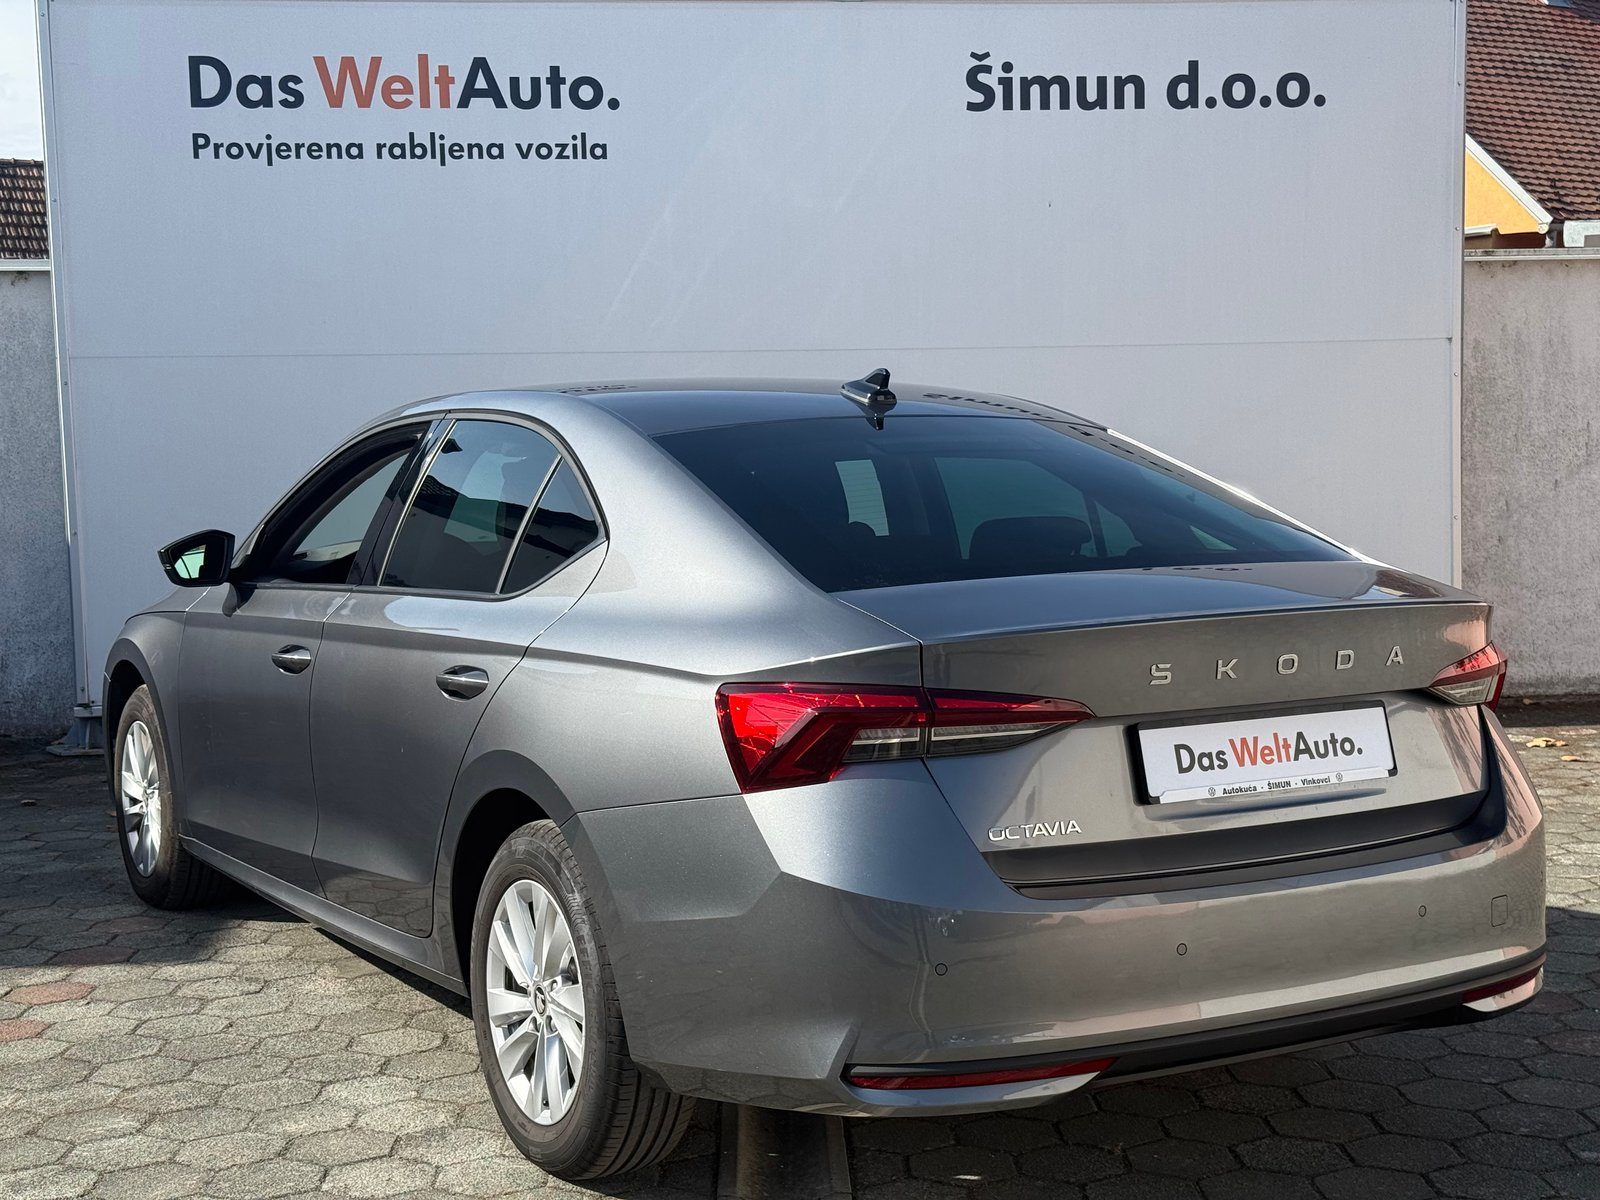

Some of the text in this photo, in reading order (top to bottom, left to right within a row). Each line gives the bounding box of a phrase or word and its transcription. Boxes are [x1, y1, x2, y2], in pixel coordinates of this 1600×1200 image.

[187, 53, 621, 111] Das WeltAuto.
[965, 51, 1327, 112] Šimun d.o.o.
[191, 131, 608, 167] Provjerena rabljena vozila
[1149, 645, 1404, 686] SKODA
[1173, 731, 1363, 774] Das WeltAuto.
[1222, 775, 1331, 796] Autokuća ŠIMUN Vinkovci
[988, 820, 1082, 842] OCTAVIA
